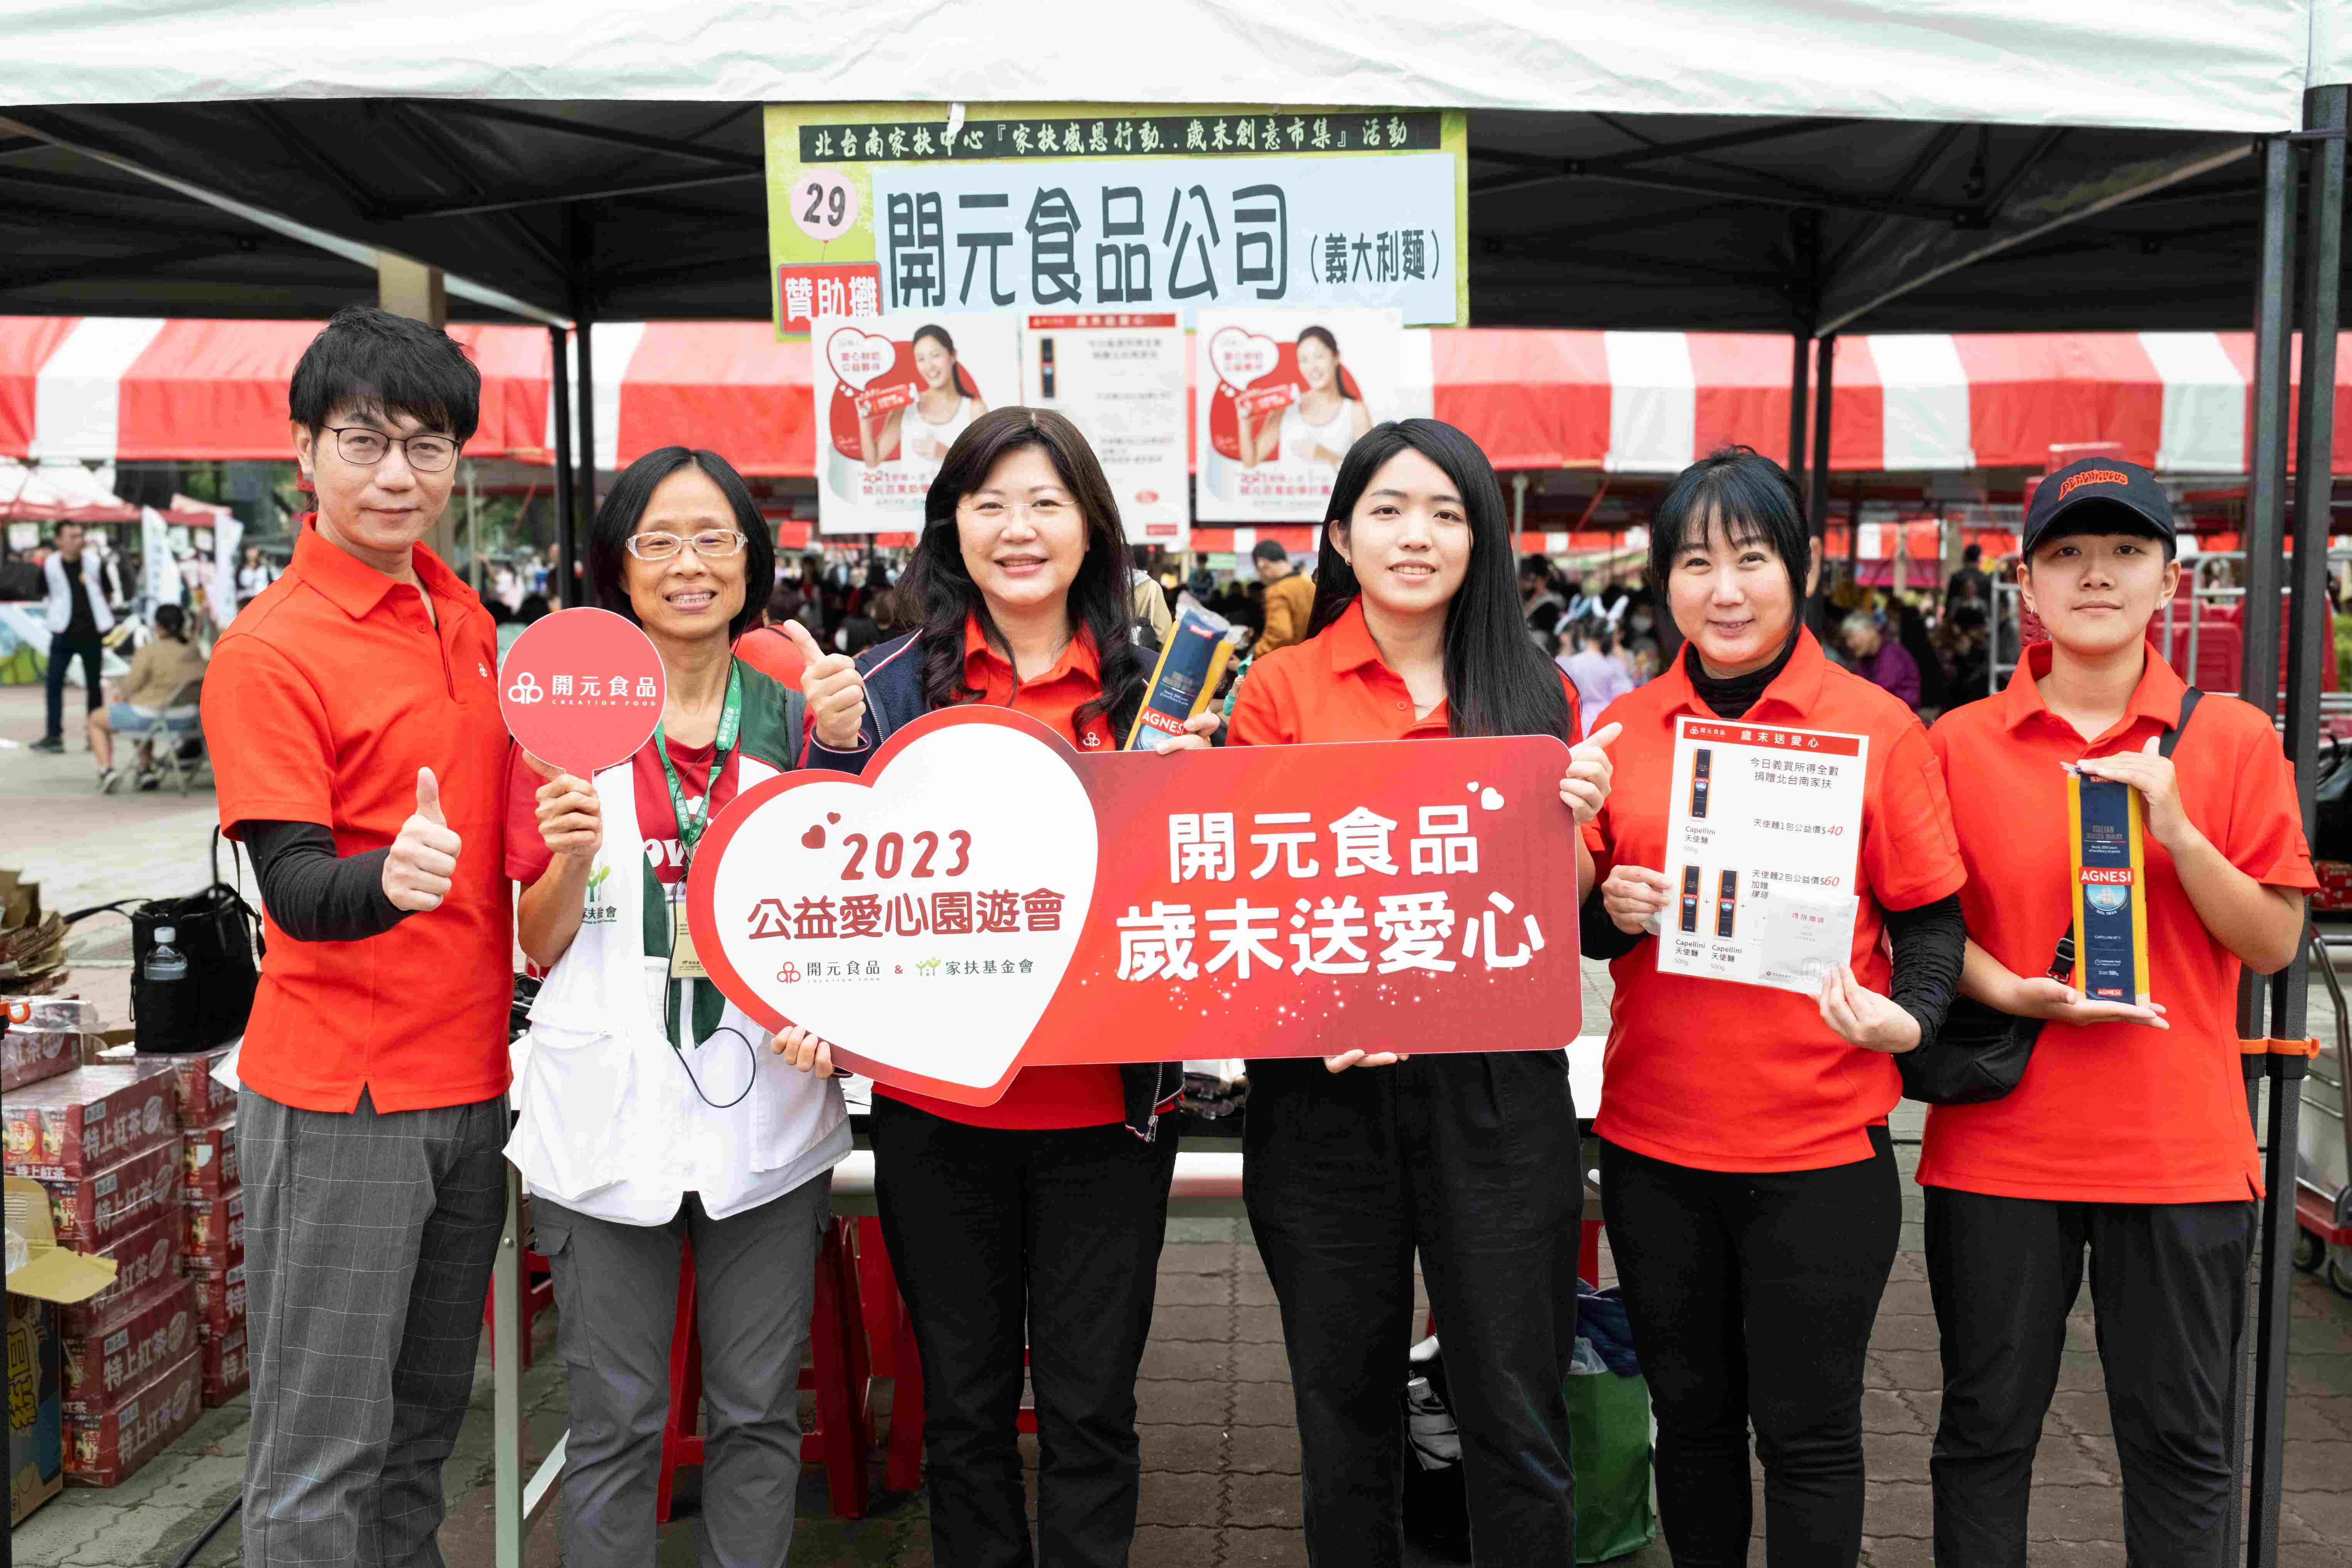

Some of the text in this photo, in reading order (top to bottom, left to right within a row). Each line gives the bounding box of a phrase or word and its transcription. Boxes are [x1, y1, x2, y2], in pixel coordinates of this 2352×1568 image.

[803, 183, 846, 226] 29
[887, 184, 1288, 308] 開元食品公司
[552, 675, 656, 697] 開元食品
[1740, 730, 1819, 748] 歲末送愛心
[1751, 758, 1839, 776] 今日義買所得全數
[1754, 771, 1832, 789] 捐贈北台南家扶
[1685, 826, 1715, 835] Capellini
[1169, 806, 1478, 883] 開元食品
[840, 830, 972, 881] 2023
[2081, 870, 2131, 882] AGNESI
[747, 888, 1065, 941] 公益愛心園遊會
[1116, 891, 1545, 982] 歲末送愛心
[1676, 939, 1705, 950] Capellini
[1712, 944, 1742, 954] Capellini
[807, 958, 1034, 976] 開元食品 & 家扶基金會
